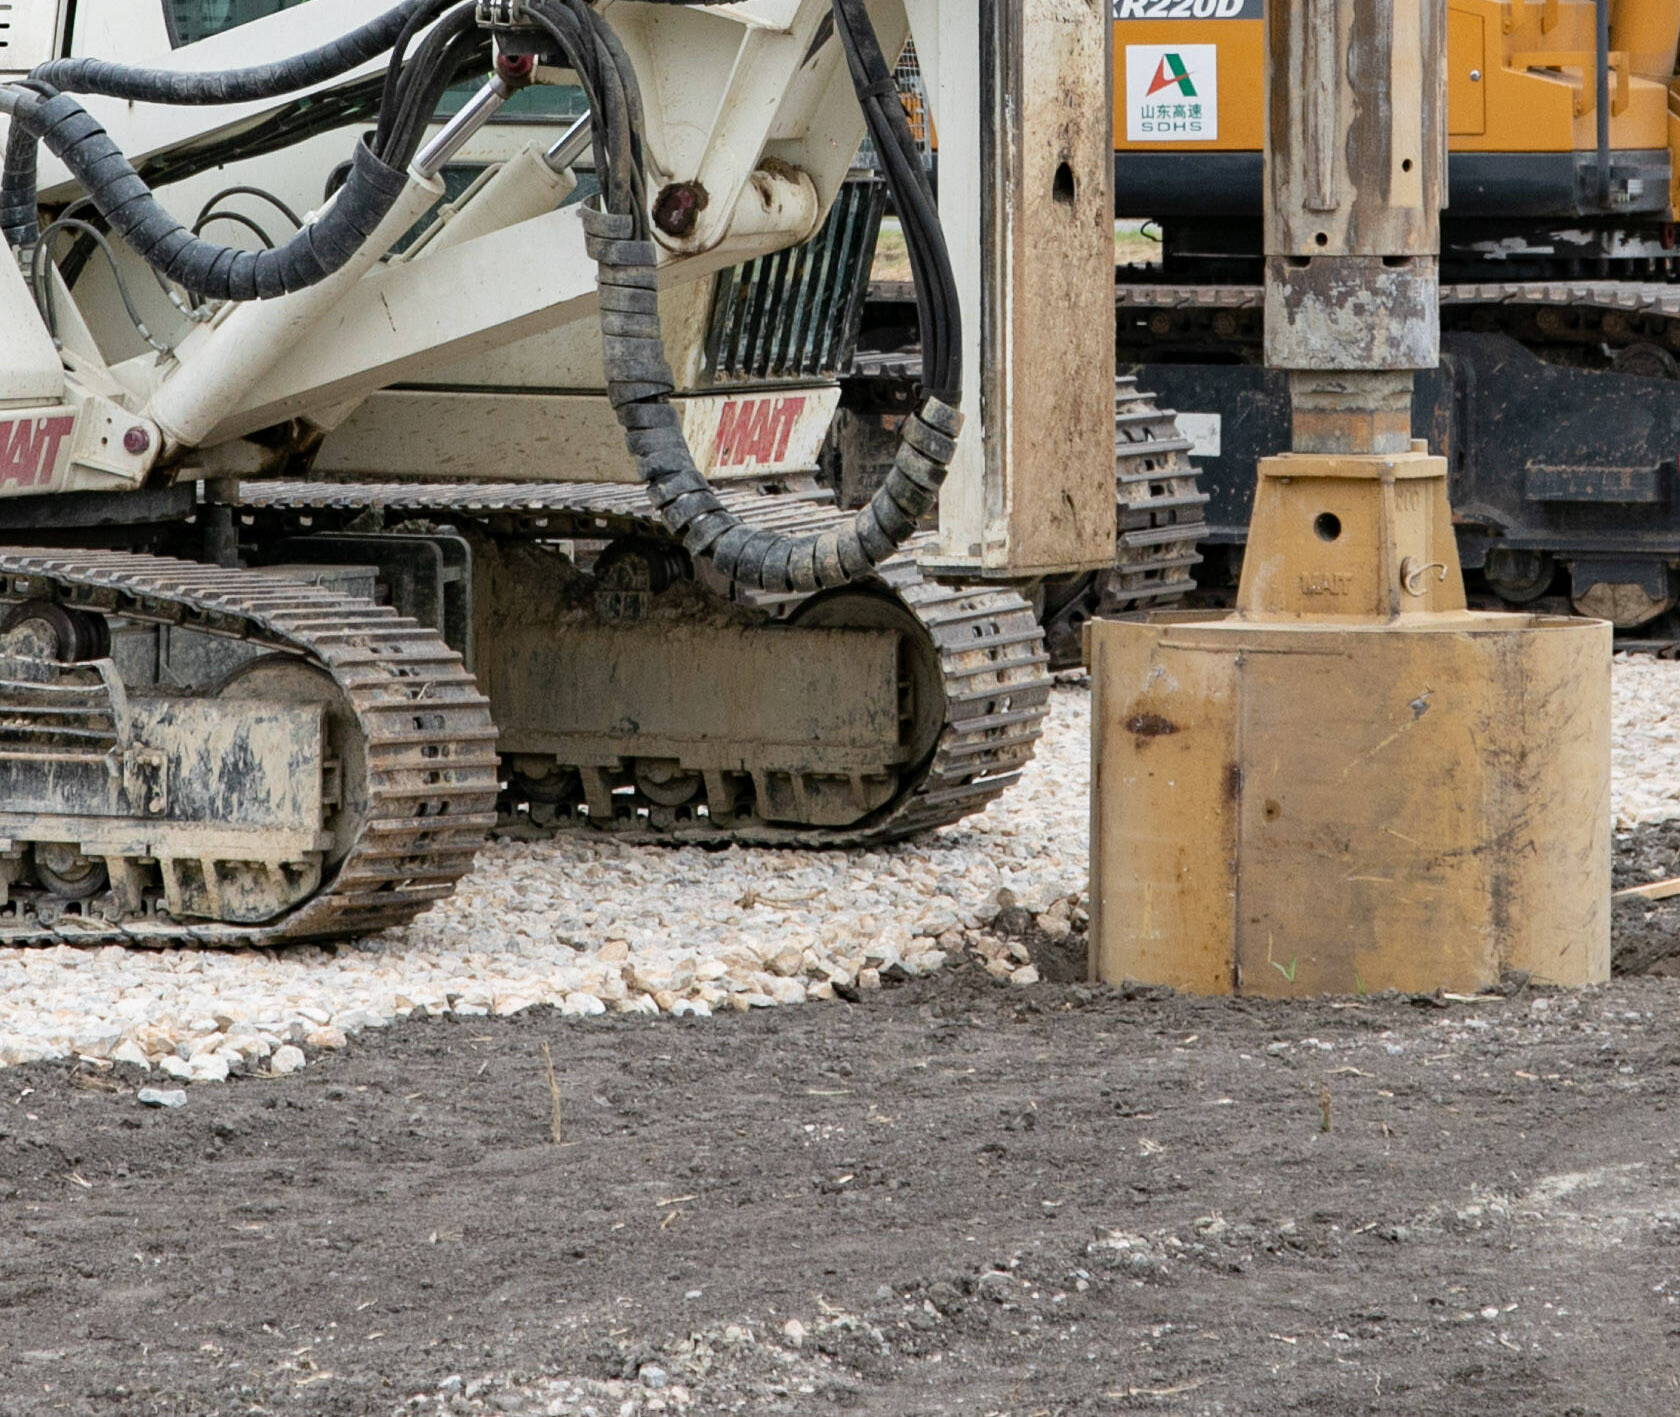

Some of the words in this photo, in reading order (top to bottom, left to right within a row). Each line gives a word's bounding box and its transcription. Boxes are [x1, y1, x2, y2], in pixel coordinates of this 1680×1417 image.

[1141, 103, 1202, 119] 山东高速
[1141, 122, 1202, 132] SDHS
